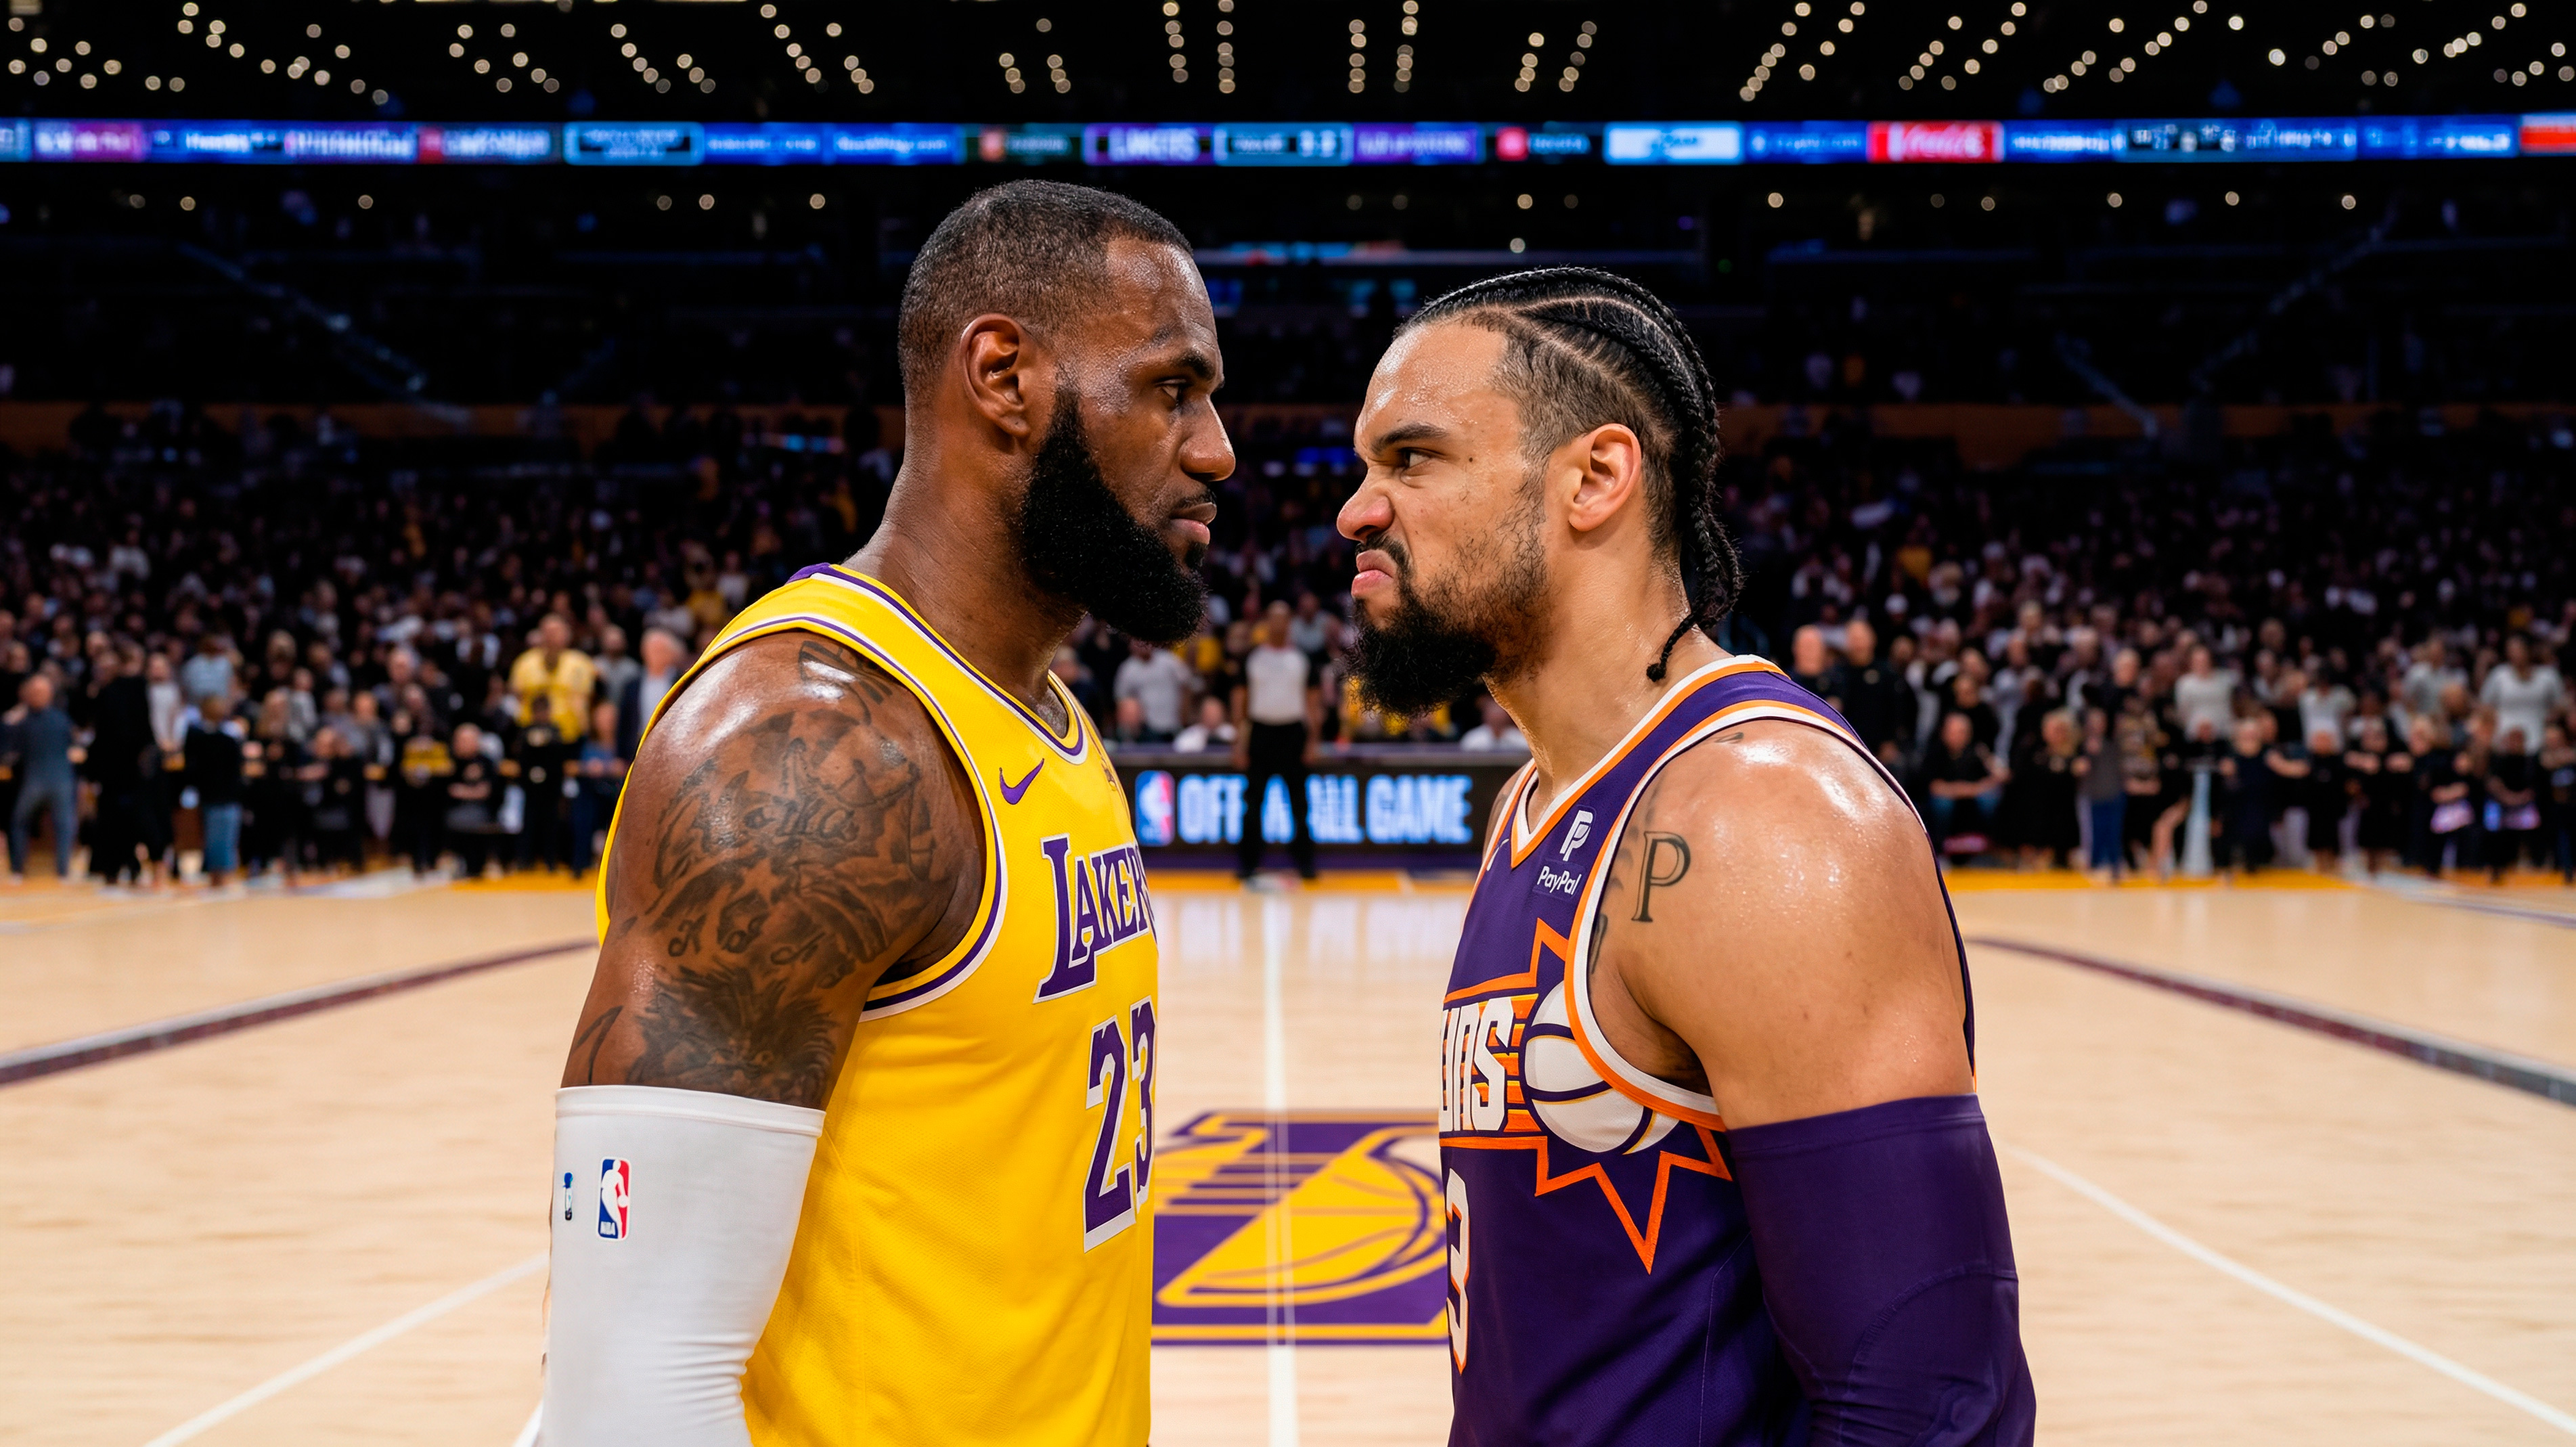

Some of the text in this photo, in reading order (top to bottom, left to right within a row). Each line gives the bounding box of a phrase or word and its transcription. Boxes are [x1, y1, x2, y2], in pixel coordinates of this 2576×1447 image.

[1178, 774, 1248, 844] OFF
[1366, 774, 1473, 844] GAME
[1536, 866, 1582, 895] PayPal
[1631, 831, 1691, 922] P
[1083, 995, 1156, 1253] 23
[1446, 1167, 1470, 1376] 3
